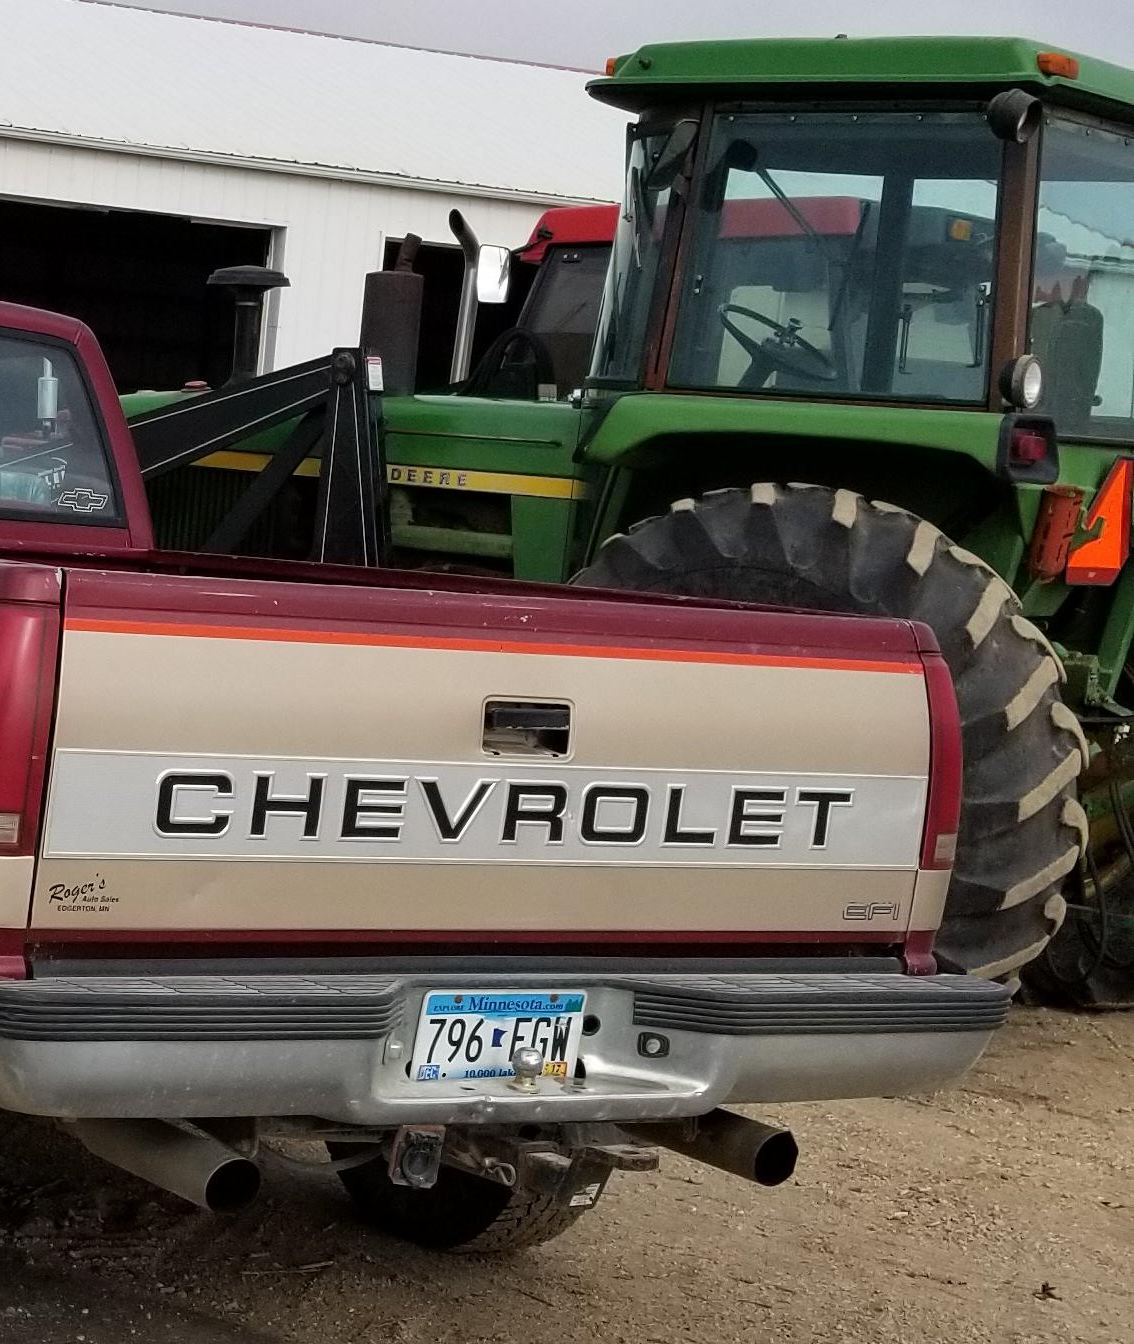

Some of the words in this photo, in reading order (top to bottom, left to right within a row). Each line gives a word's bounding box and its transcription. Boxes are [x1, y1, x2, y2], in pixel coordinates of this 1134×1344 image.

[391, 468, 467, 487] DEERE
[153, 768, 855, 850] CHEVROLET
[49, 873, 106, 904] Roger's
[100, 895, 119, 903] Sales
[842, 902, 900, 921] EFI
[426, 1018, 485, 1063] 796
[498, 1068, 516, 1077] lak
